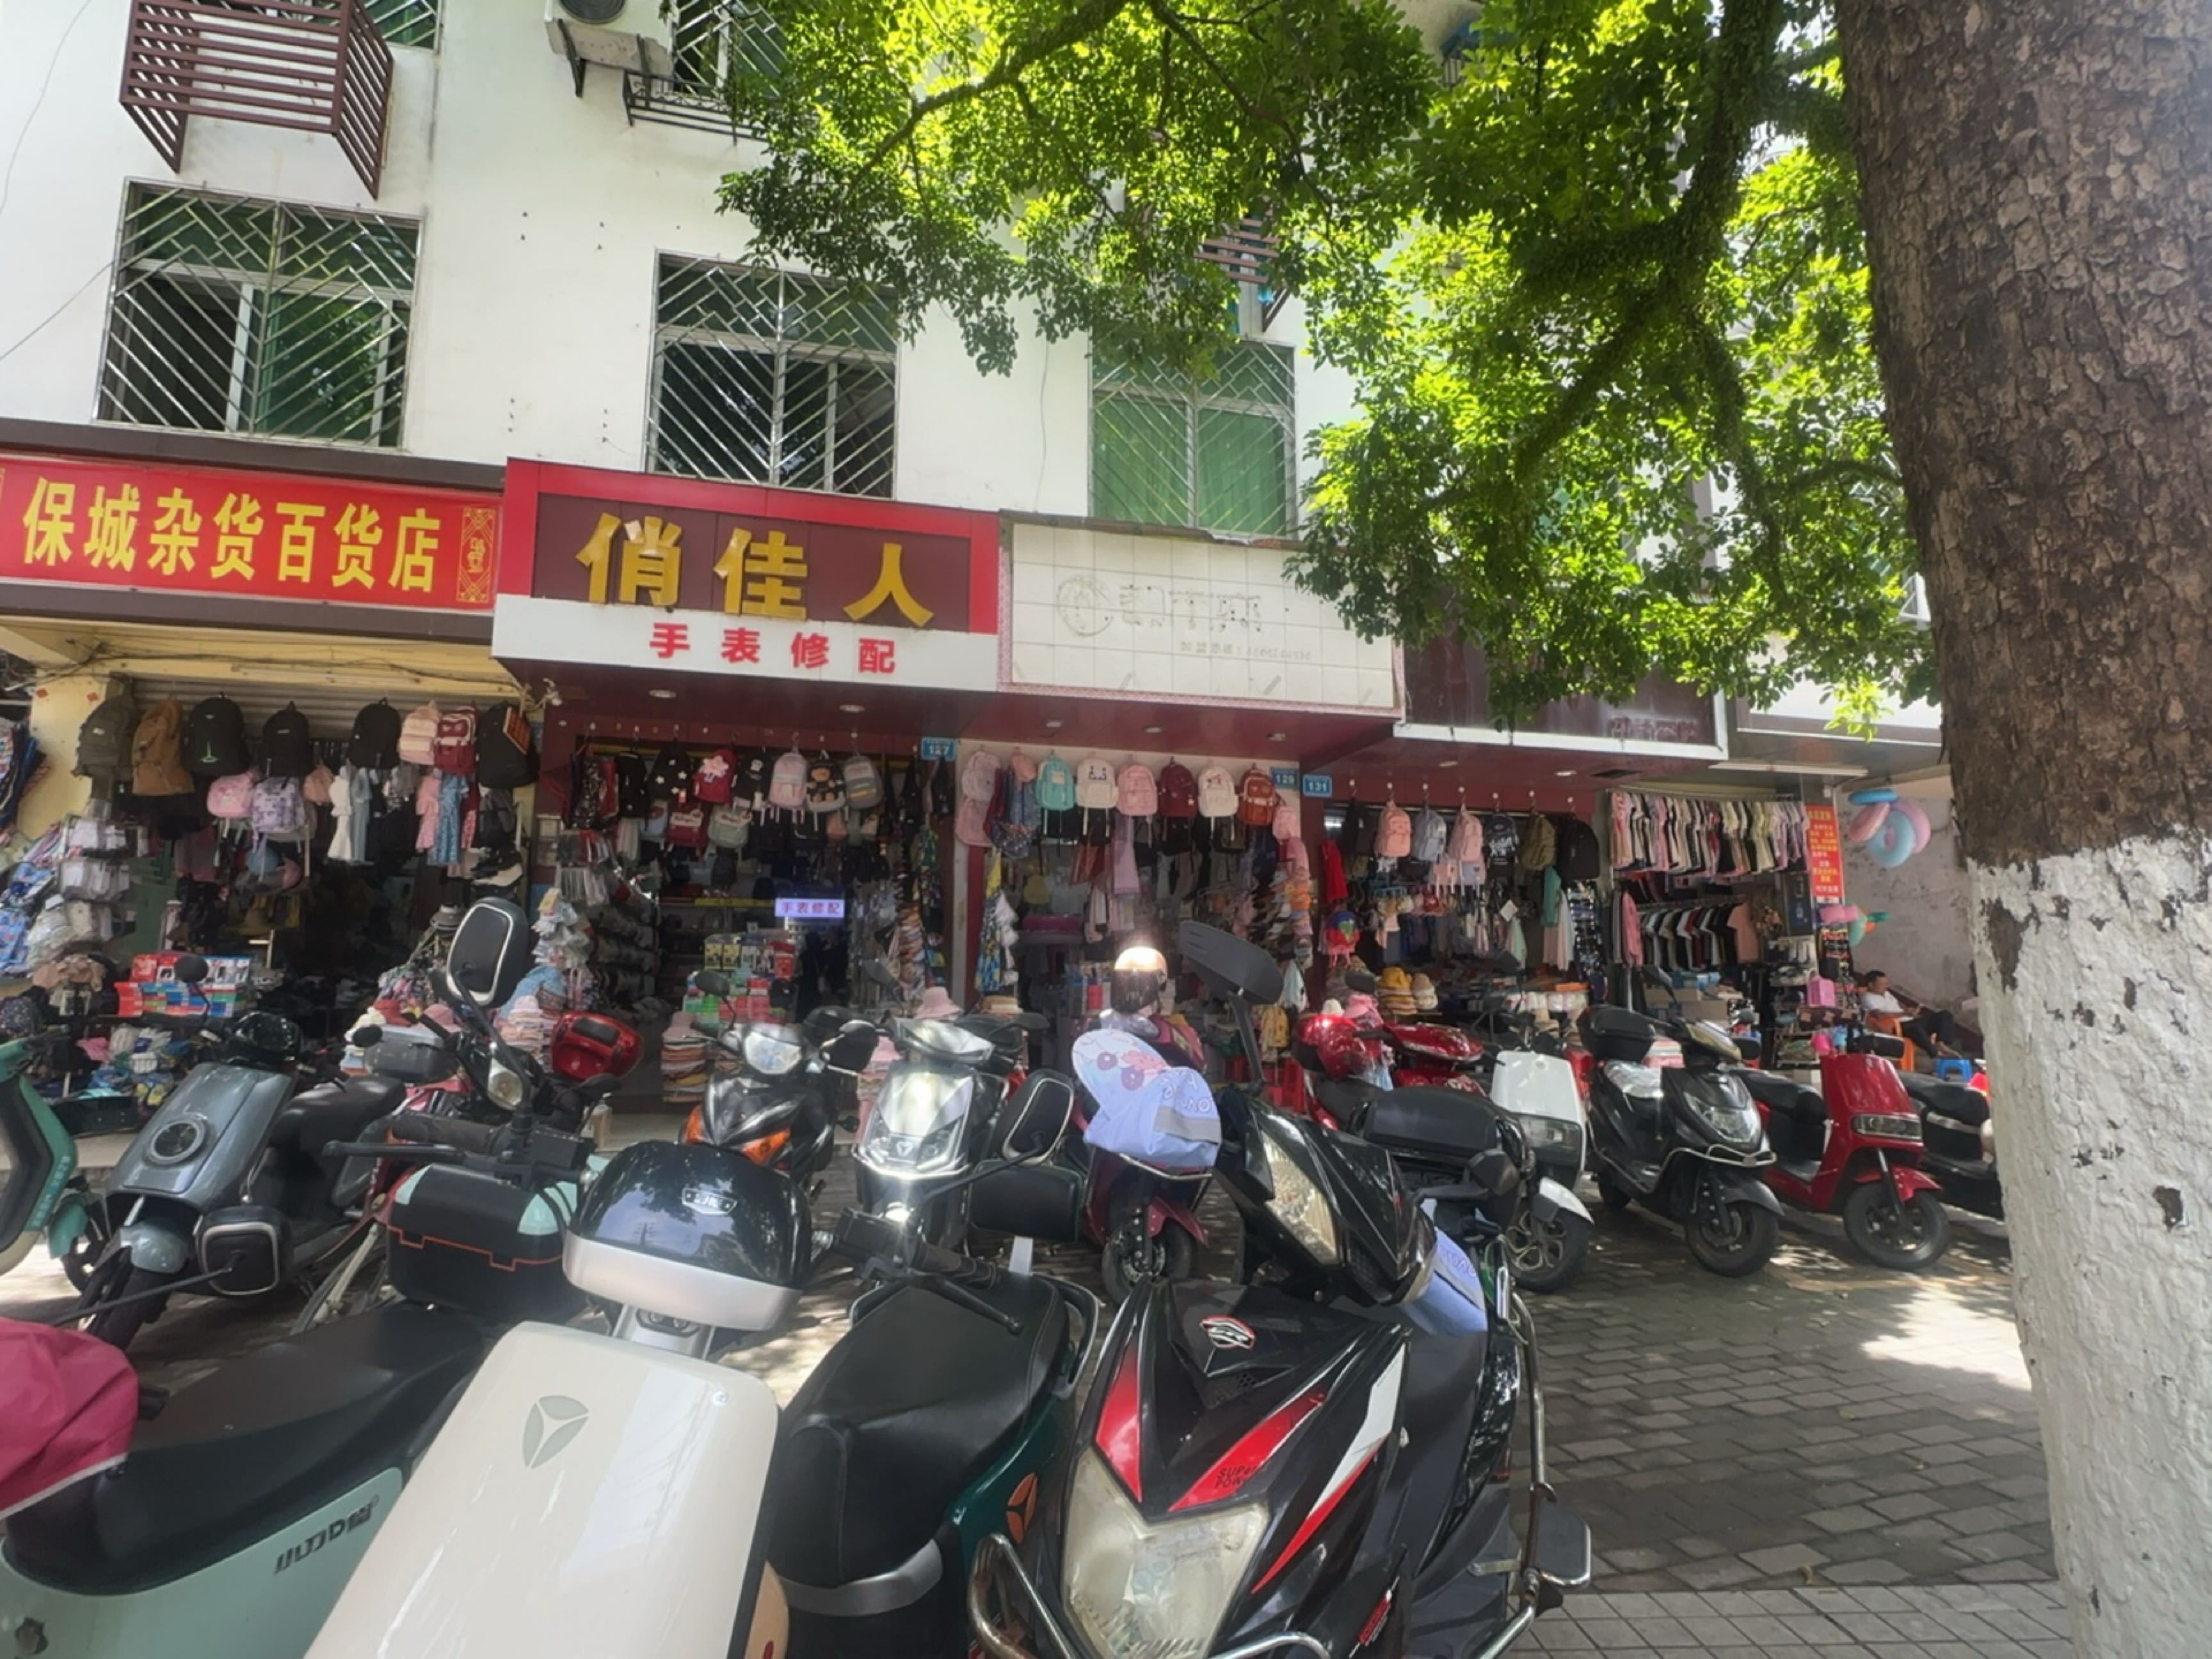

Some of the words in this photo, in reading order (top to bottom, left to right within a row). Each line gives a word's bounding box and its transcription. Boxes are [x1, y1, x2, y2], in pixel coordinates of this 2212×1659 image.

[23, 476, 440, 591] 保城杂货百货店
[575, 512, 934, 627] 俏佳人
[650, 622, 896, 674] 手表修配
[929, 744, 950, 756] 127
[1309, 781, 1327, 792] 131
[782, 901, 840, 915] 手表修配
